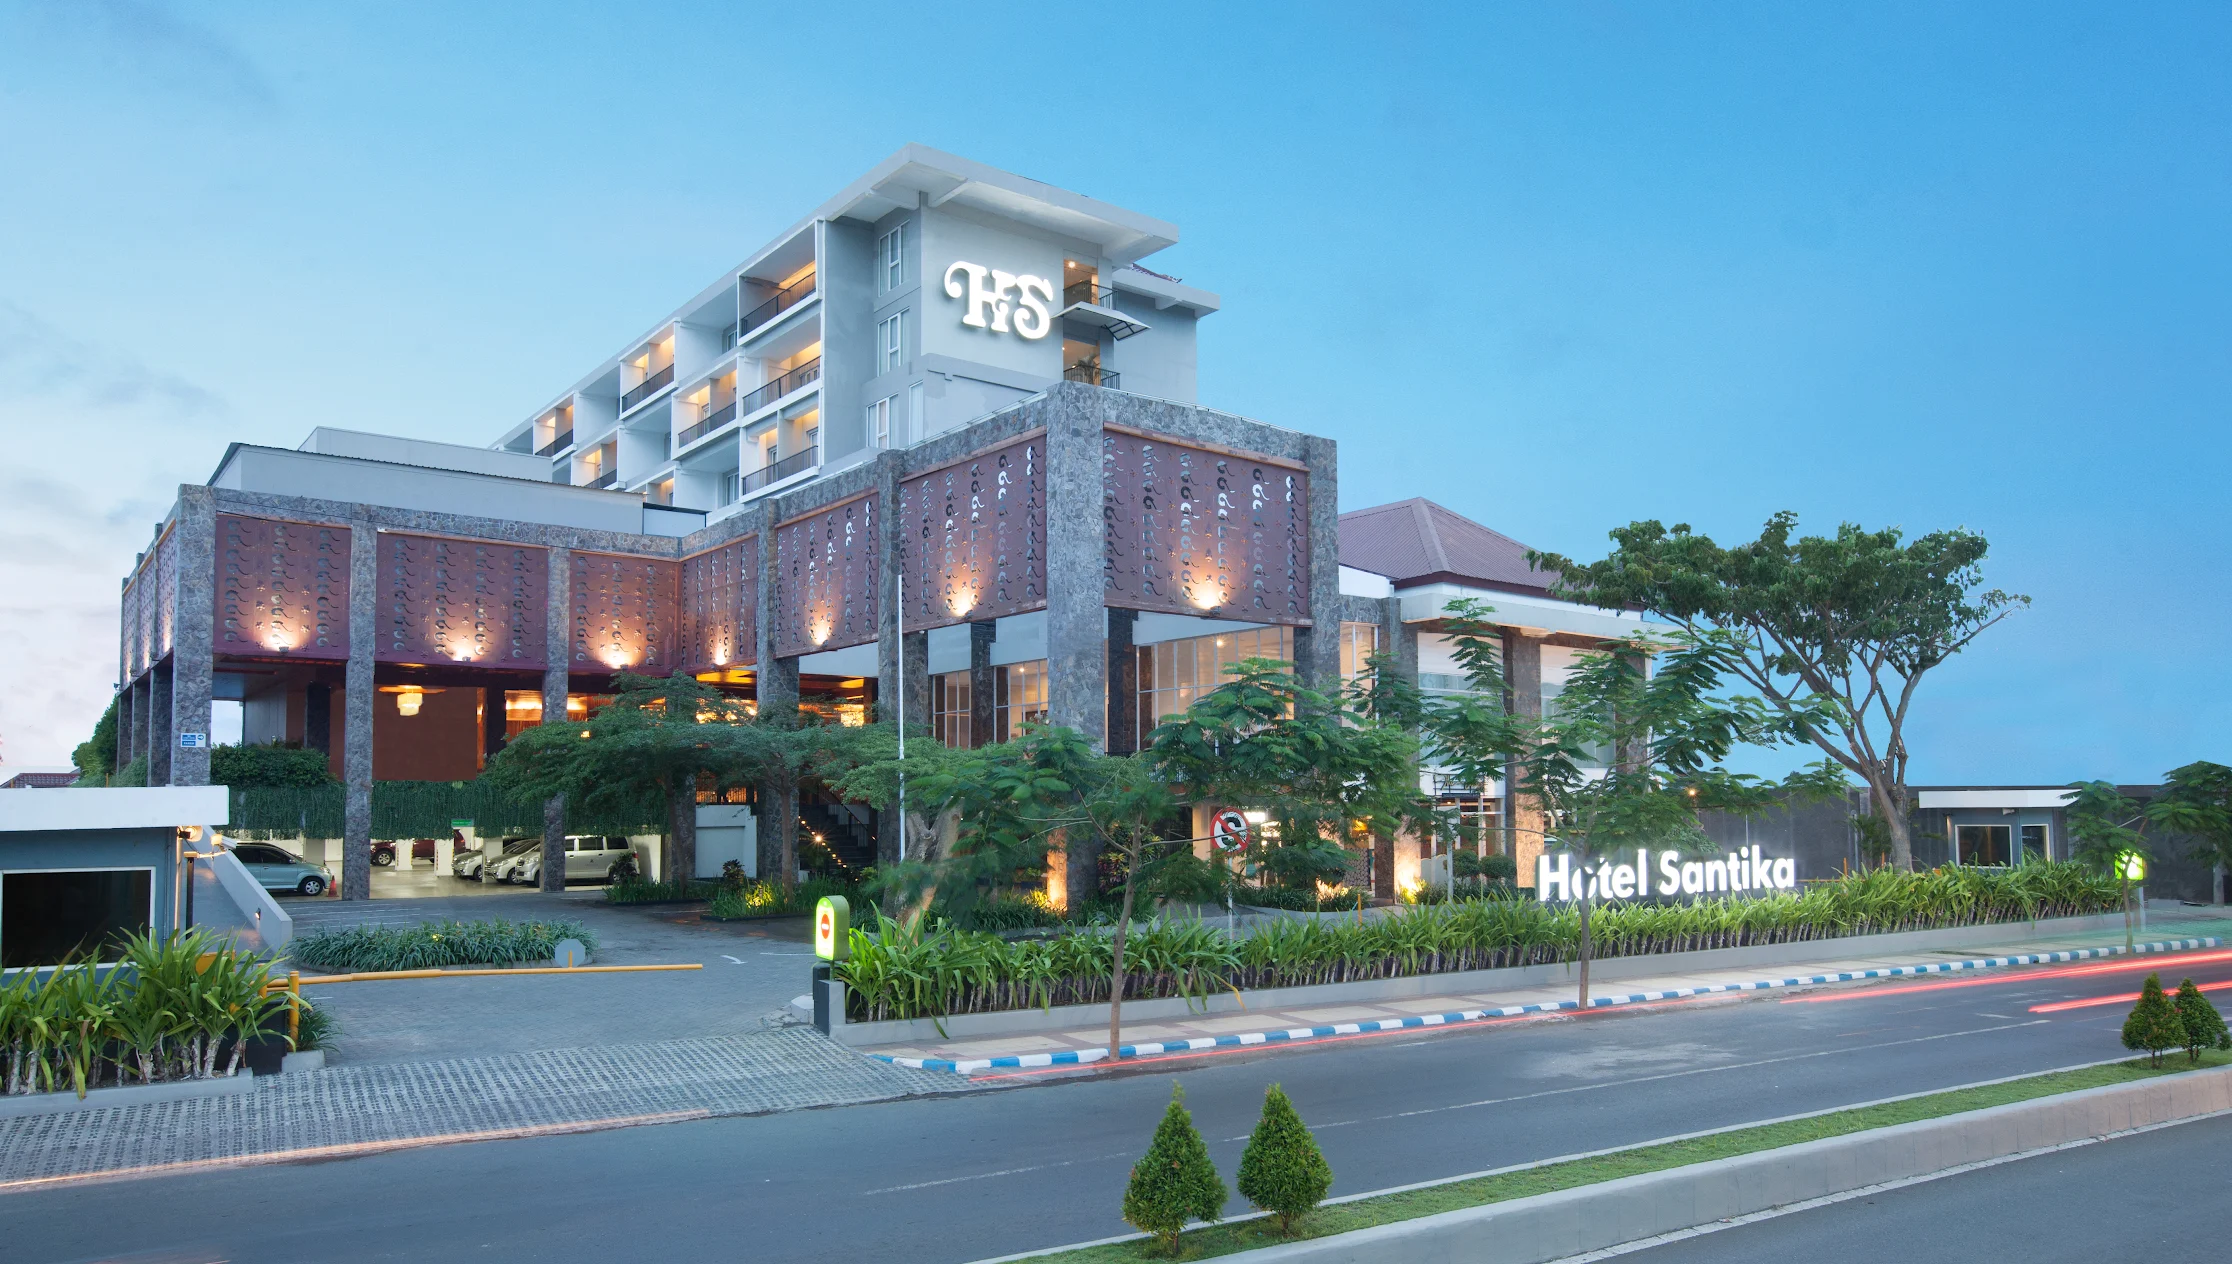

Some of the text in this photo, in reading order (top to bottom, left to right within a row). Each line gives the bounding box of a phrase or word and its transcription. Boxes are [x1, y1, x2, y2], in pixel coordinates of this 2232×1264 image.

[944, 261, 1054, 340] HS
[1538, 845, 1796, 901] Hotel Santika
